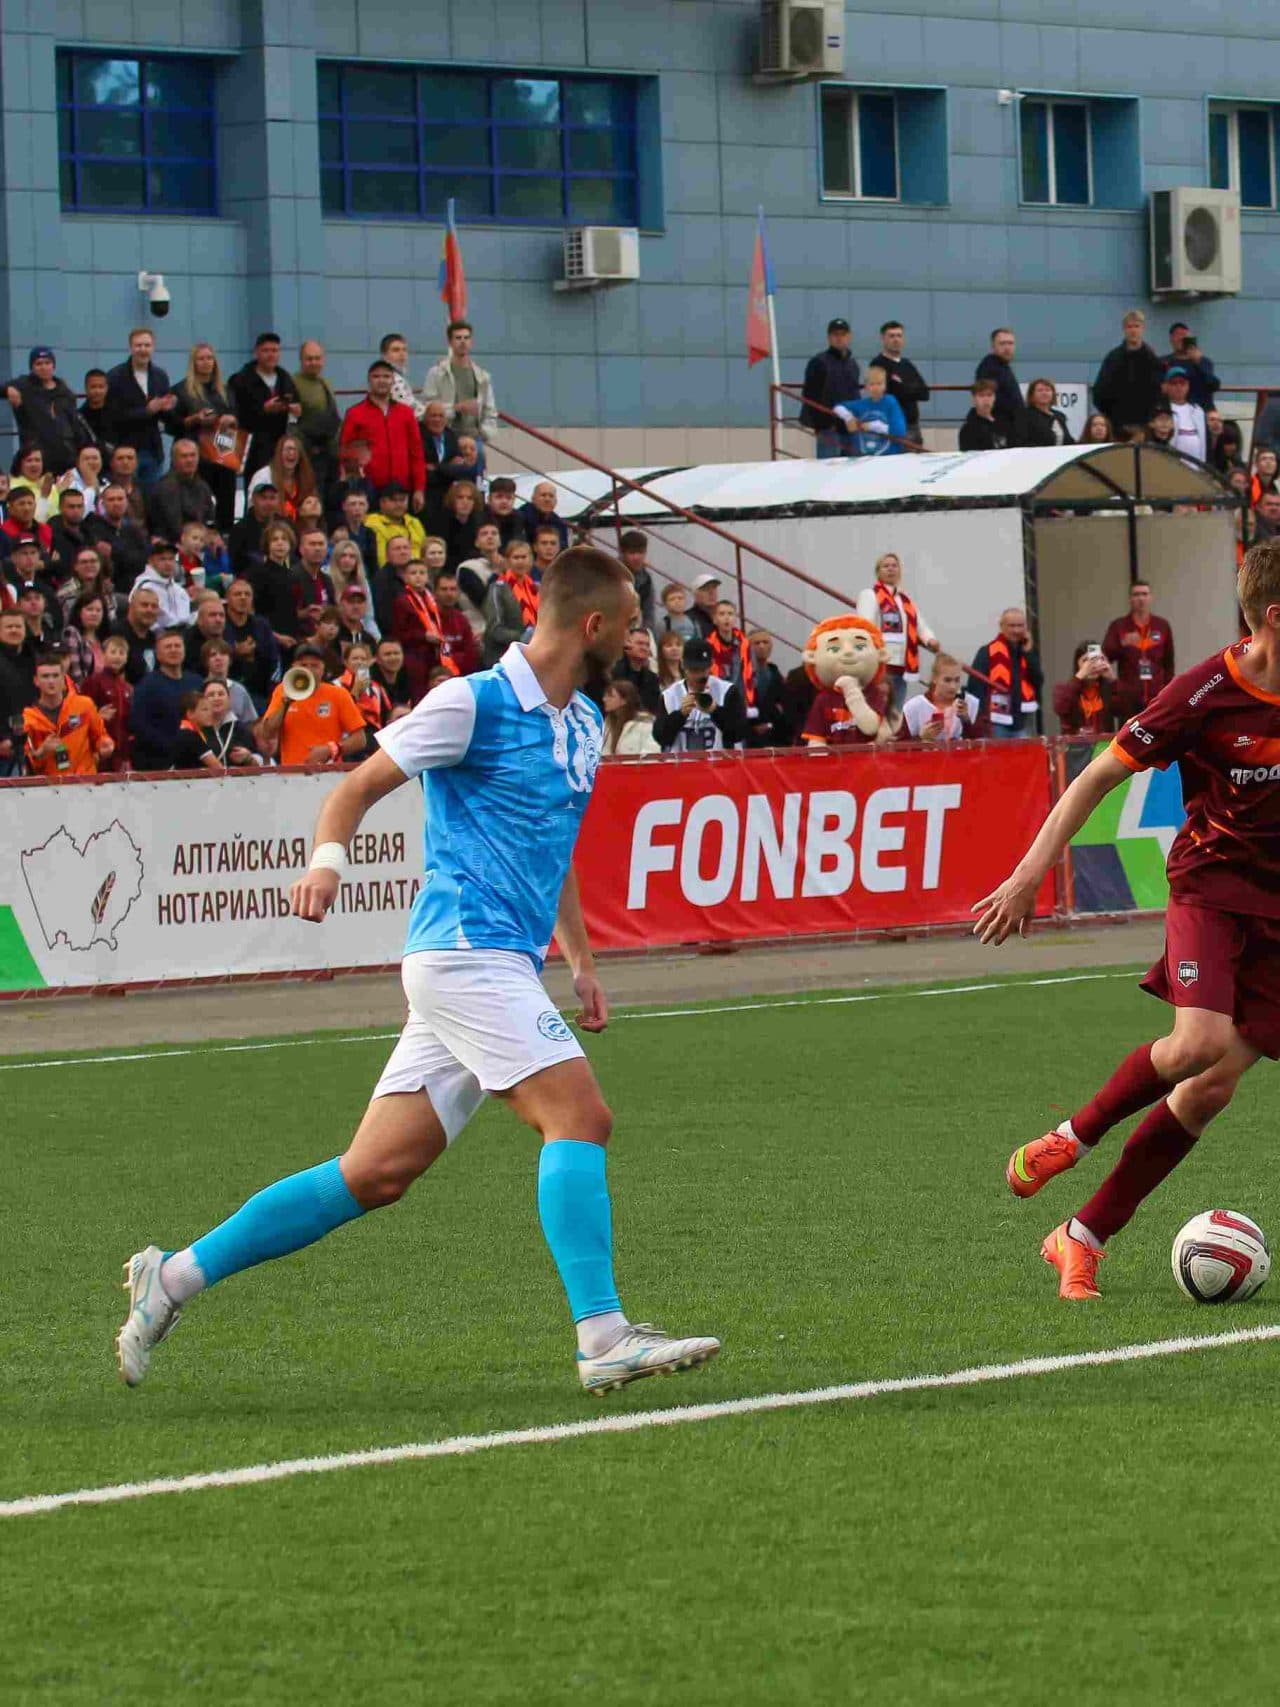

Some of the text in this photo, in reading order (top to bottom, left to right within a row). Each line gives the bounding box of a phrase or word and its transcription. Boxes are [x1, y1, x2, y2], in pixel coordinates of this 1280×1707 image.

[173, 832, 406, 876] АЛТАЙСКАЯ ЕВАЯ
[626, 783, 962, 910] FONBET
[158, 887, 335, 926] НОТАРИАЛЬ
